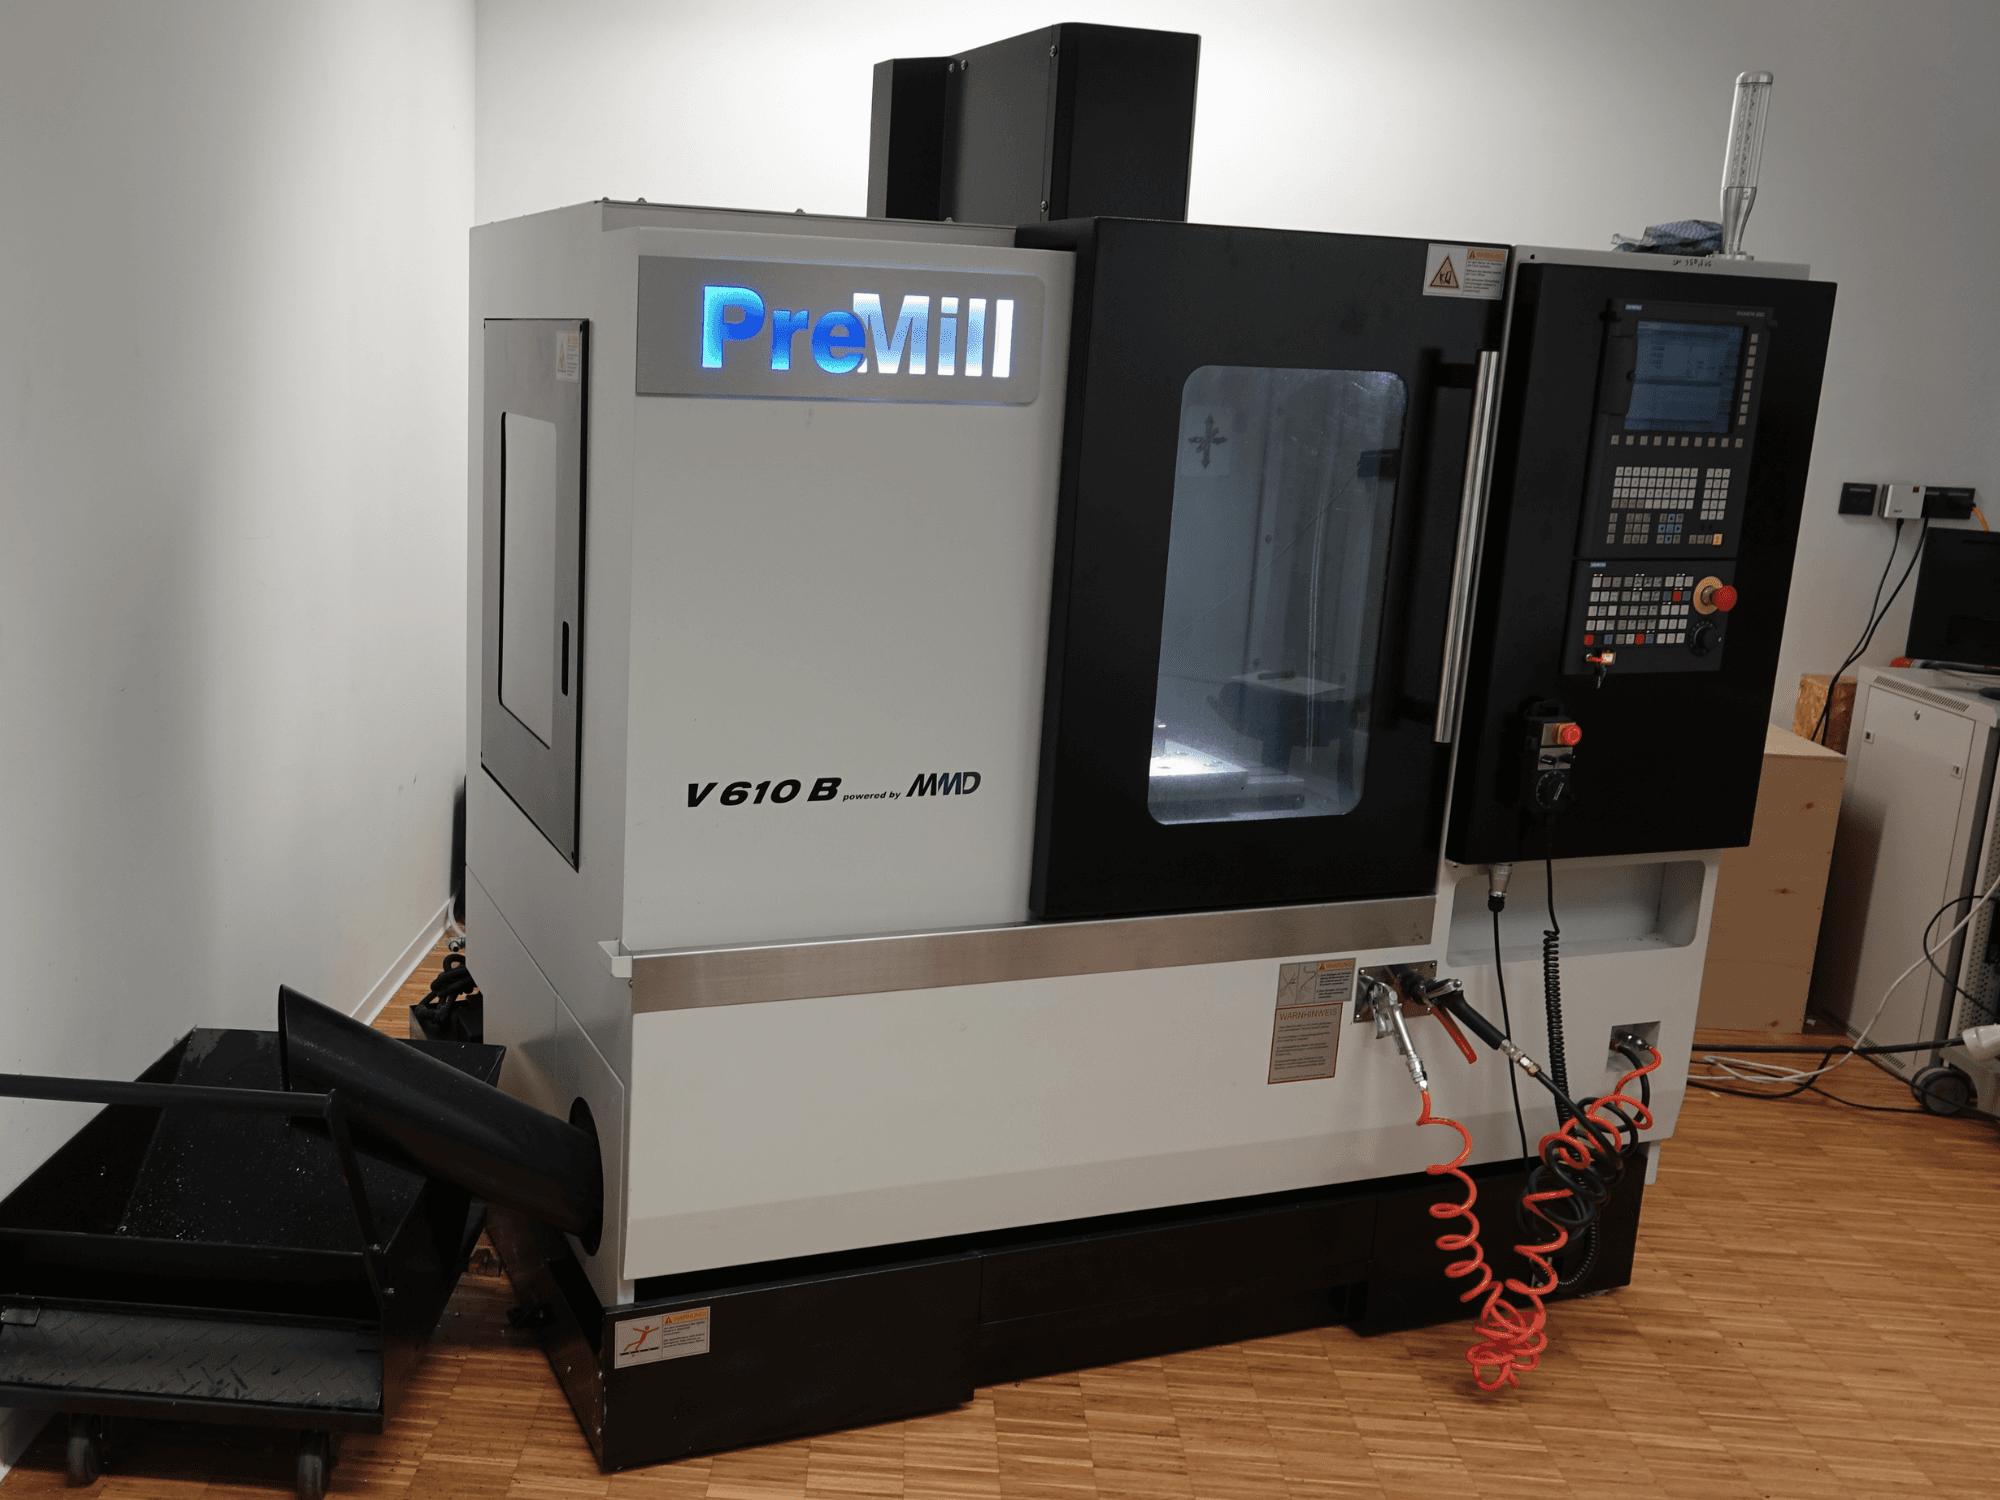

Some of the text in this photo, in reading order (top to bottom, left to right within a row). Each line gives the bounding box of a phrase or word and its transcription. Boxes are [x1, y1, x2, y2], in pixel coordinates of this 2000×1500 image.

[702, 284, 1014, 378] PreMill
[688, 771, 982, 807] V 610 B powered by MMD
[1279, 1008, 1338, 1020] WARNHINWEIS
